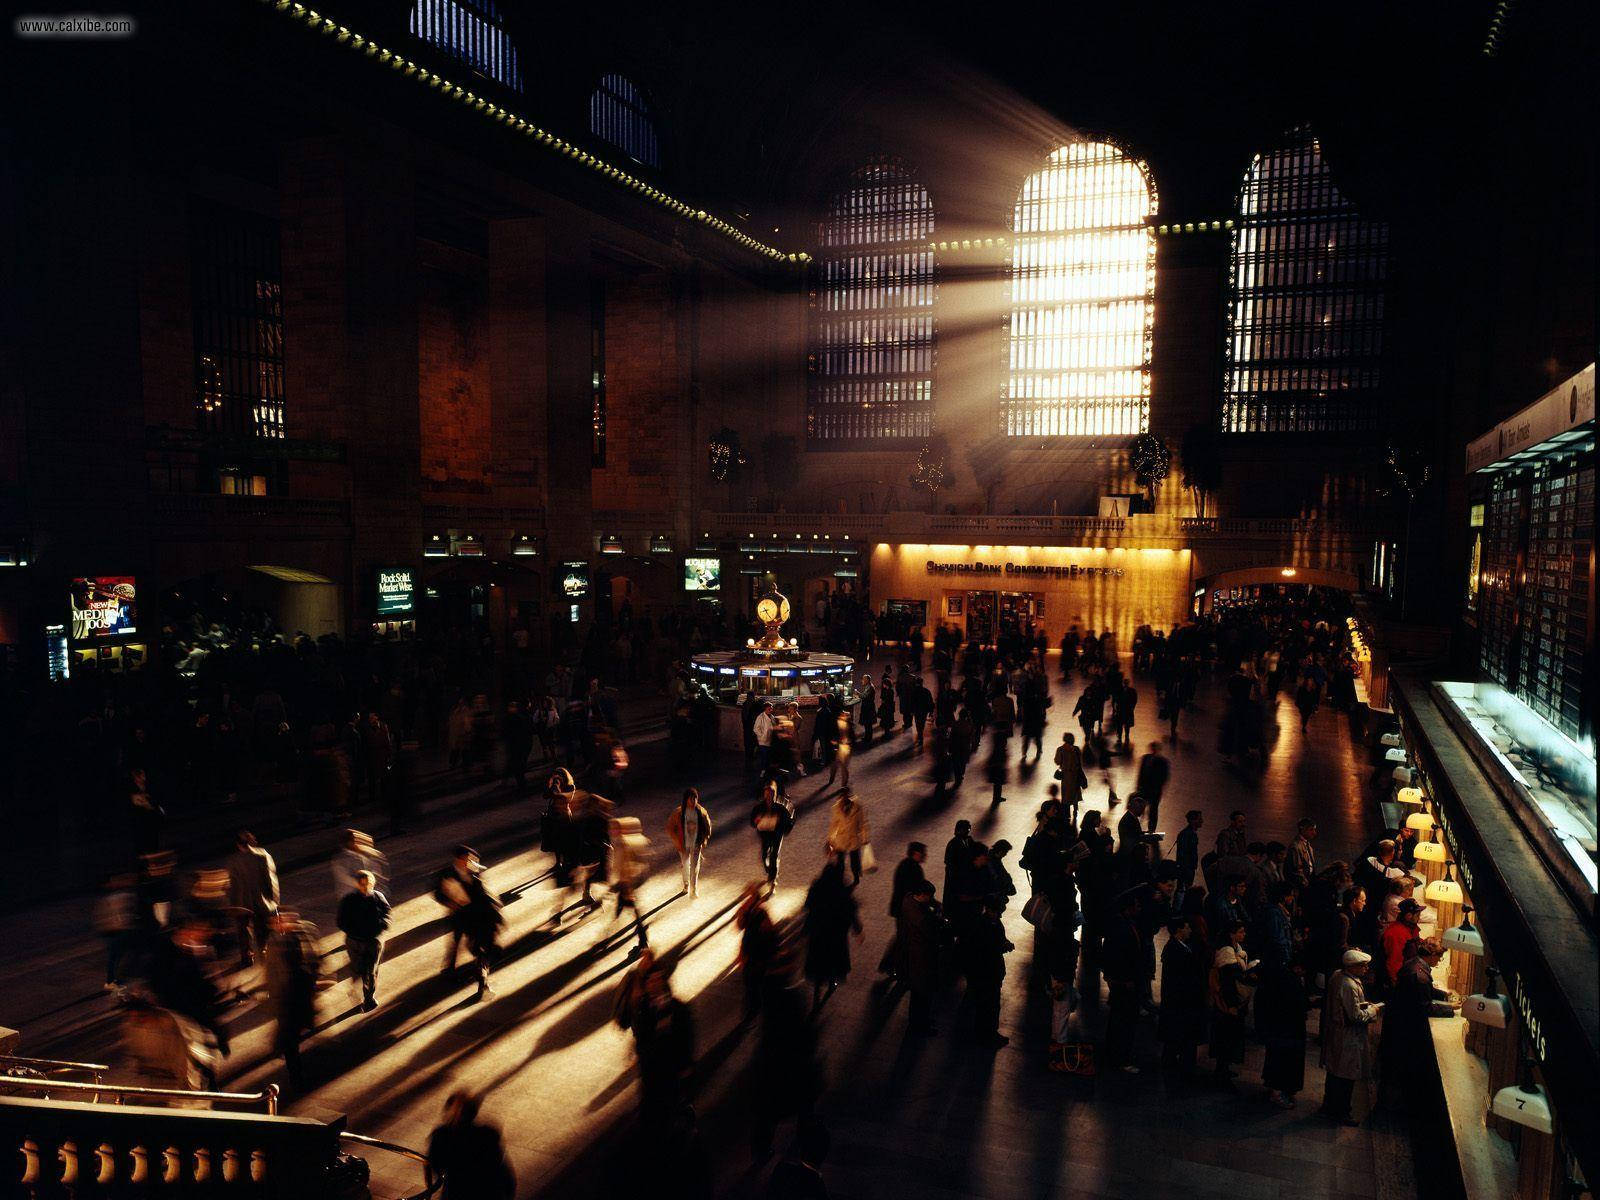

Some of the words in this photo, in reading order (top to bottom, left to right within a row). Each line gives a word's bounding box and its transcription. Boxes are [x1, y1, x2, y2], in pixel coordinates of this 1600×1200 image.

[381, 573, 396, 583] Rock
[379, 583, 399, 593] Market
[1457, 933, 1466, 943] 11
[1477, 1001, 1486, 1012] 9
[1515, 971, 1546, 1062] Tickets
[1515, 1098, 1526, 1110] 7
